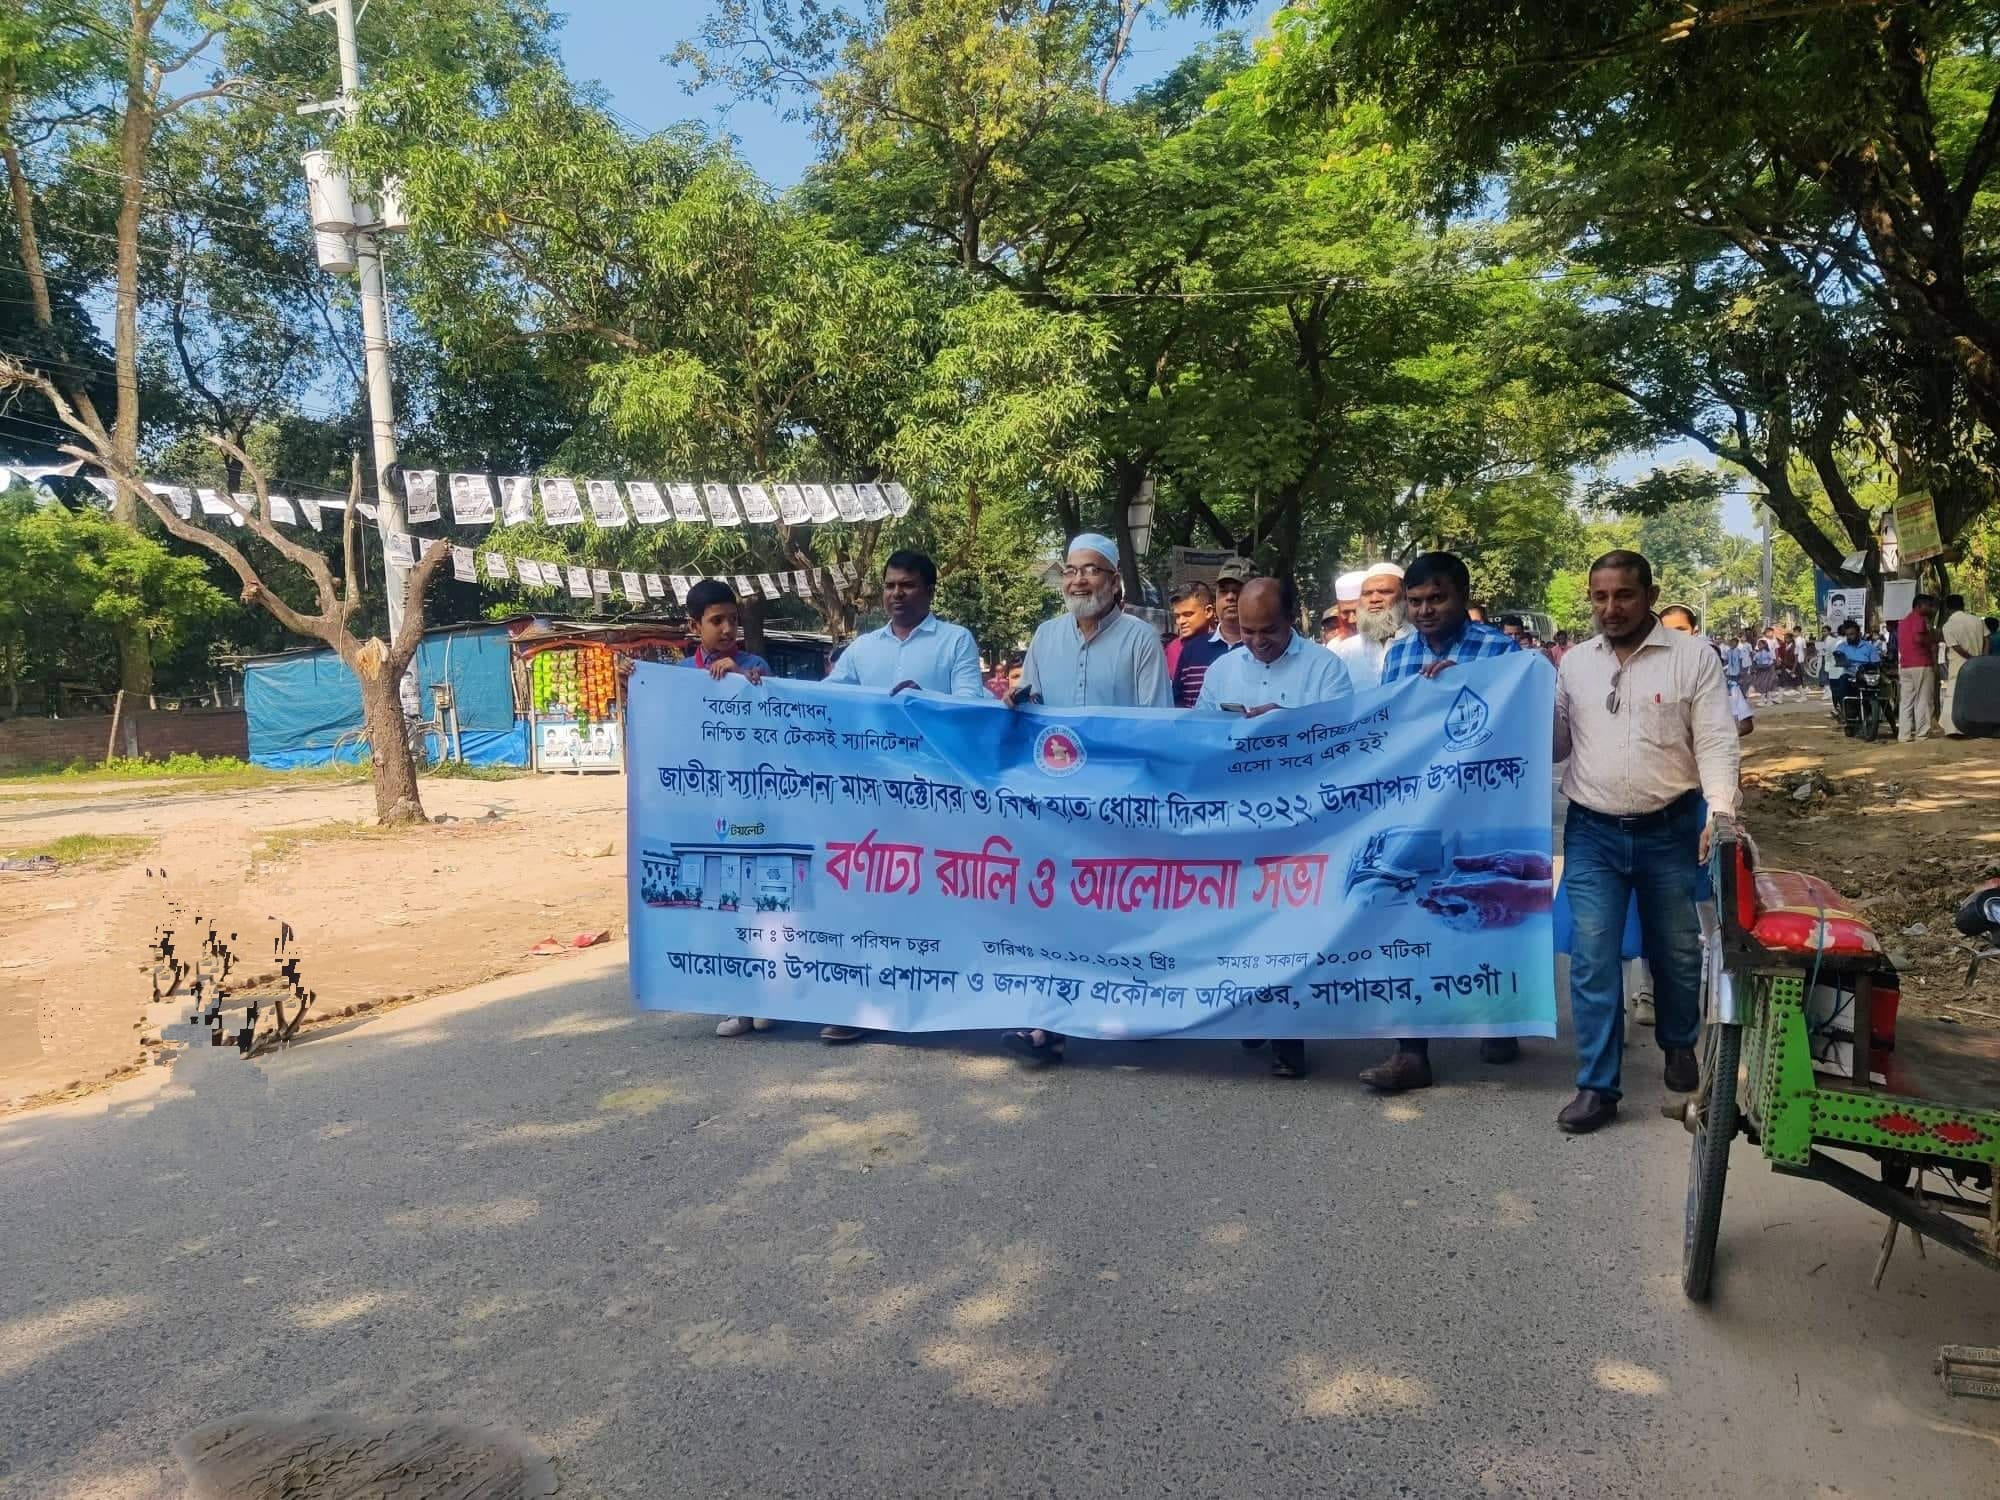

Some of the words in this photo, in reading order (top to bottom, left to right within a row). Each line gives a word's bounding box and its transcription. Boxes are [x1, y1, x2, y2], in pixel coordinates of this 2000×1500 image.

[758, 697, 832, 724] পরিশোধন,
[701, 721, 747, 742] নিশ্চিত
[752, 728, 778, 744] হবে
[785, 725, 837, 748] টেকসই
[1228, 758, 1272, 773] এসো
[1278, 754, 1313, 768] সবে
[1321, 740, 1351, 760] এক
[658, 759, 725, 797] জাতীয়
[726, 762, 837, 803] স্যানিটেশন
[839, 773, 880, 805] মাস
[883, 774, 966, 813] অক্টোবর
[970, 789, 990, 812] ও
[1046, 794, 1093, 823] হাত
[1100, 794, 1163, 828] ধোয়া
[1167, 792, 1230, 829] দিবস
[1318, 775, 1422, 814] উদযাপন
[1428, 757, 1528, 793] উপলক্ষে
[825, 829, 924, 896] বর্ণাঢ্য
[1028, 858, 1056, 909] ও
[1071, 858, 1242, 913] আলোচনা
[1251, 854, 1329, 909] সভা
[735, 927, 764, 943] স্থান
[783, 925, 845, 947] উপজেলা
[851, 931, 901, 951] পরিষদ
[1040, 950, 1144, 970] ২০.১০.২০২২
[1265, 952, 1310, 969] সকাল
[1316, 950, 1372, 965] ১০.০০
[1379, 939, 1432, 960] ঘটিকা
[784, 953, 872, 988] উপজেলা
[879, 964, 959, 992] প্রশাসন
[967, 972, 983, 992] ও
[993, 971, 1085, 1007] জনস্বাস্থ্য
[1091, 976, 1188, 1008] প্রকৌশল
[1309, 975, 1422, 1009] সাপাহার,
